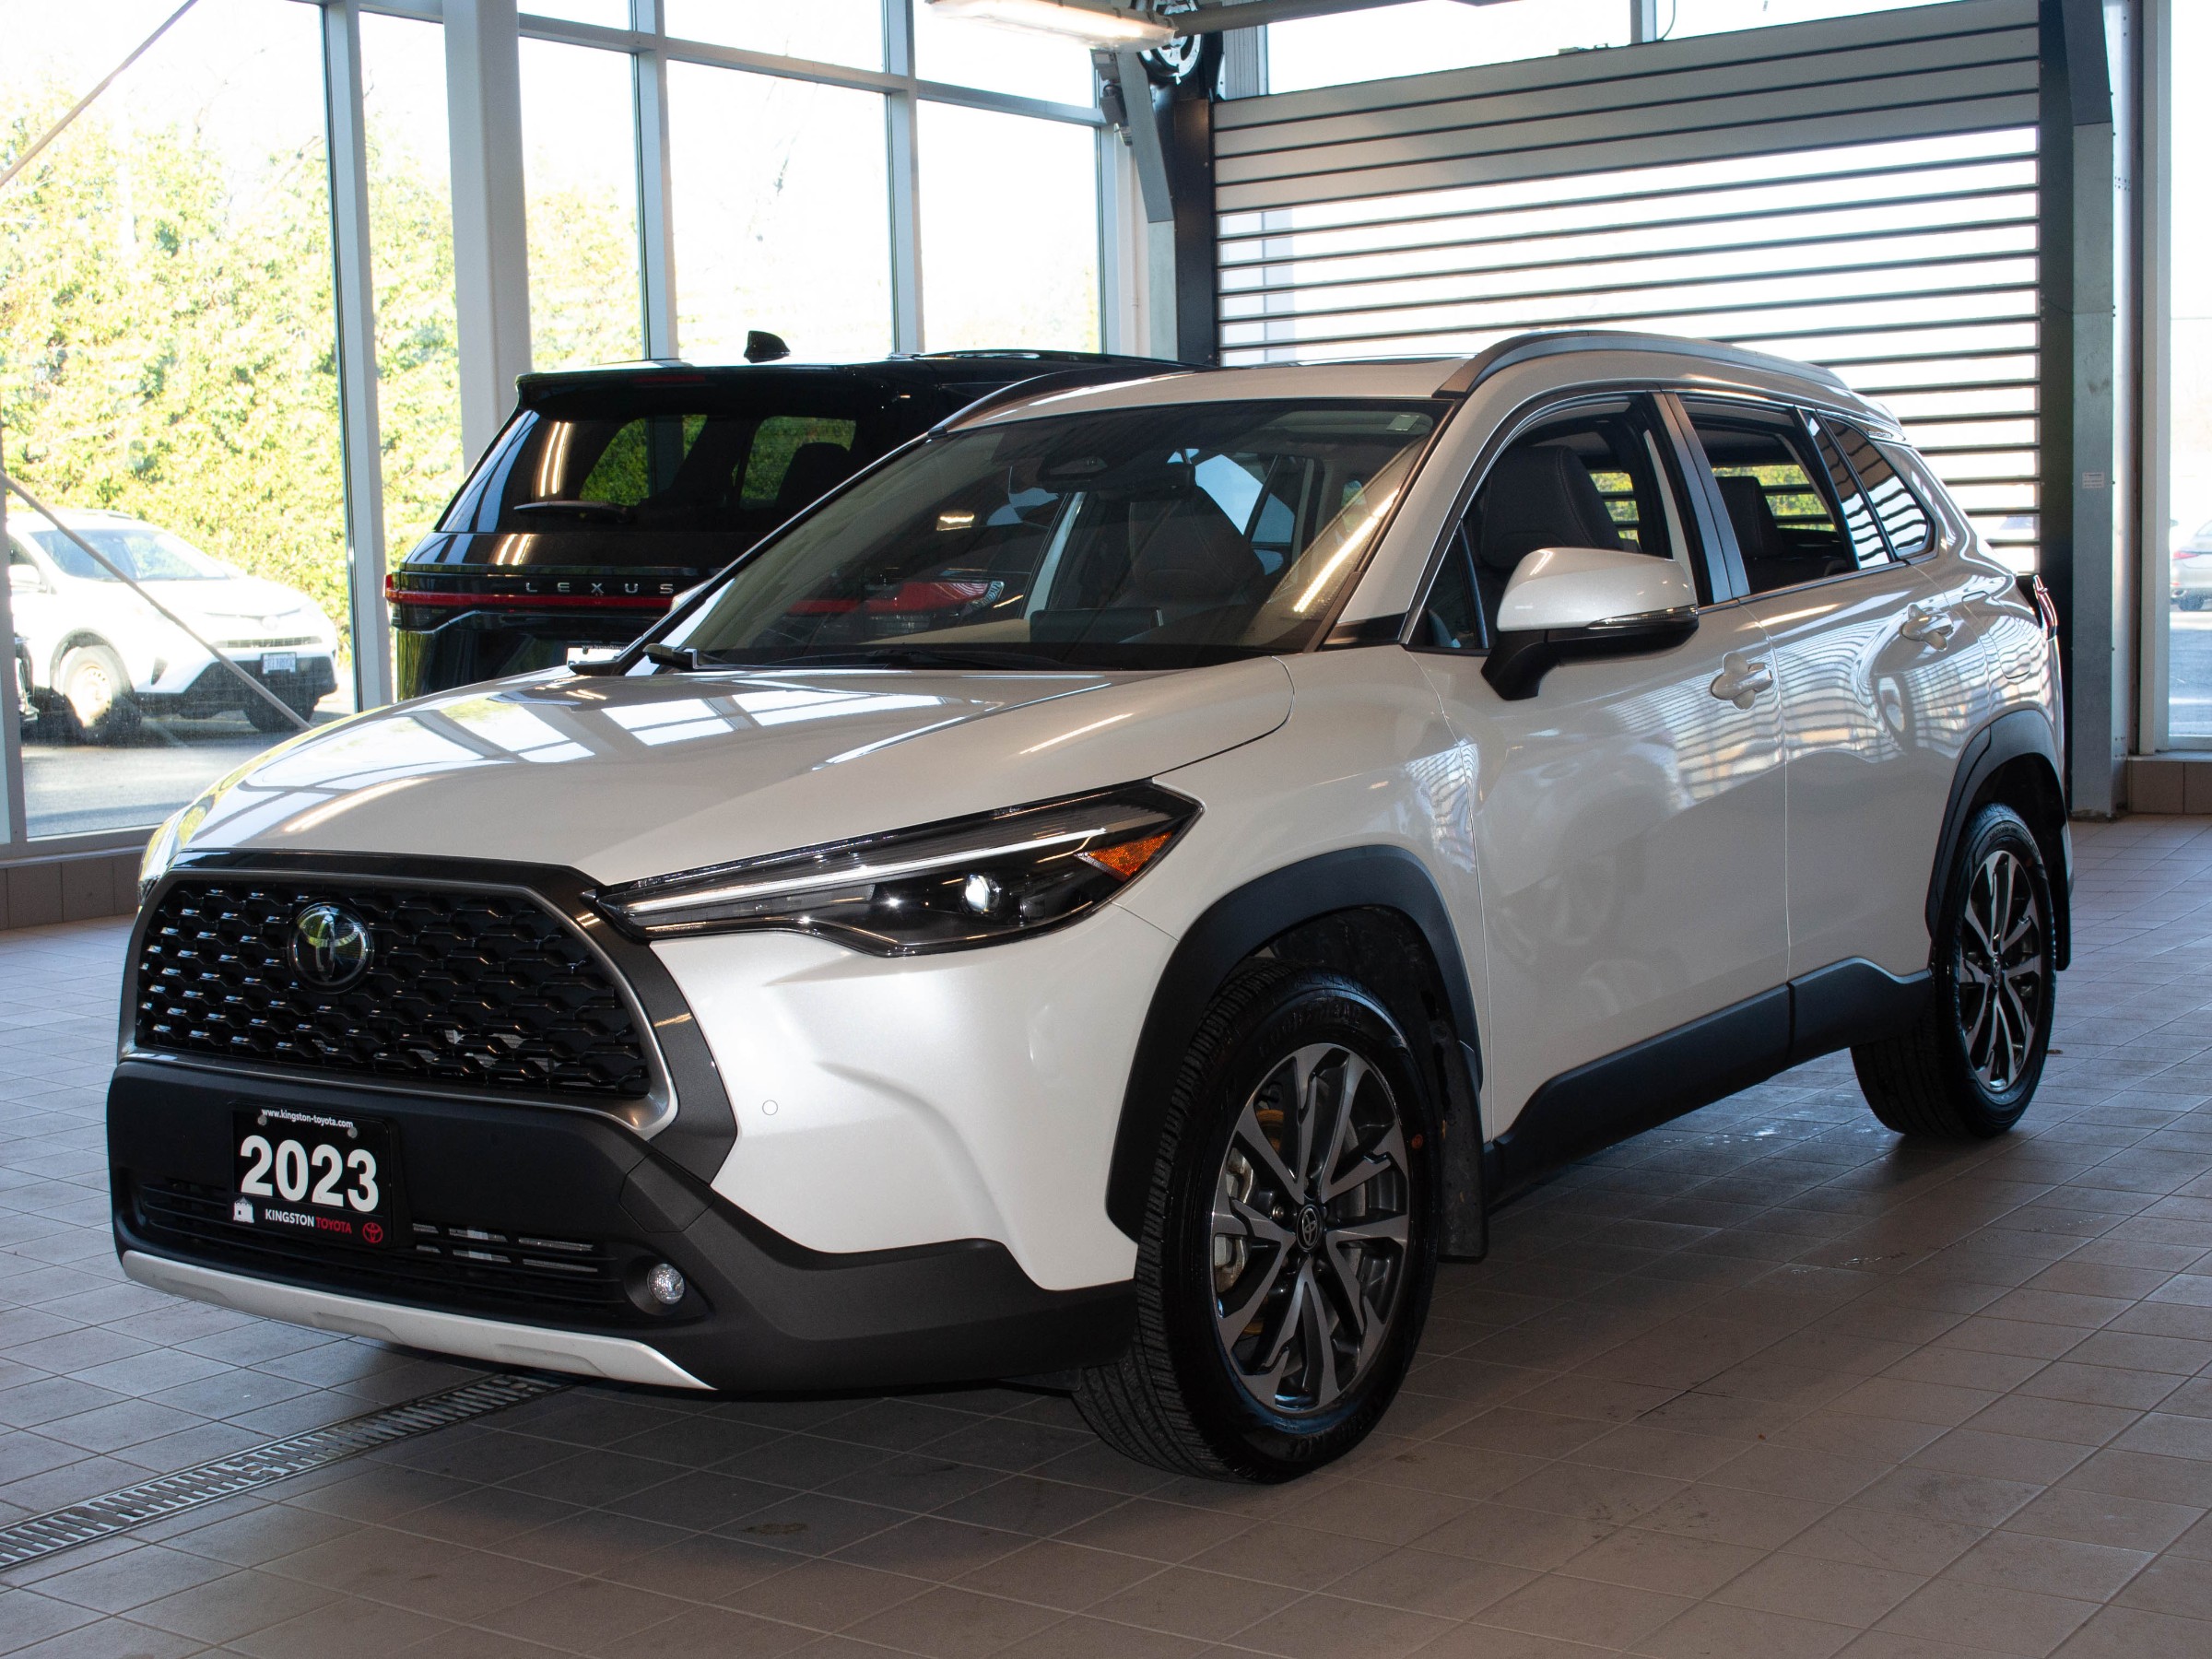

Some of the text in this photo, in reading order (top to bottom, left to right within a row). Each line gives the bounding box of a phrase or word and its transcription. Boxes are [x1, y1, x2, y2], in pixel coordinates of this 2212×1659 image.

[525, 582, 674, 594] LEXUS
[262, 1109, 353, 1128] www.kingston-toyota.com
[240, 1135, 379, 1212] 2023
[265, 1208, 352, 1234] KINGSTON TOYOTA
